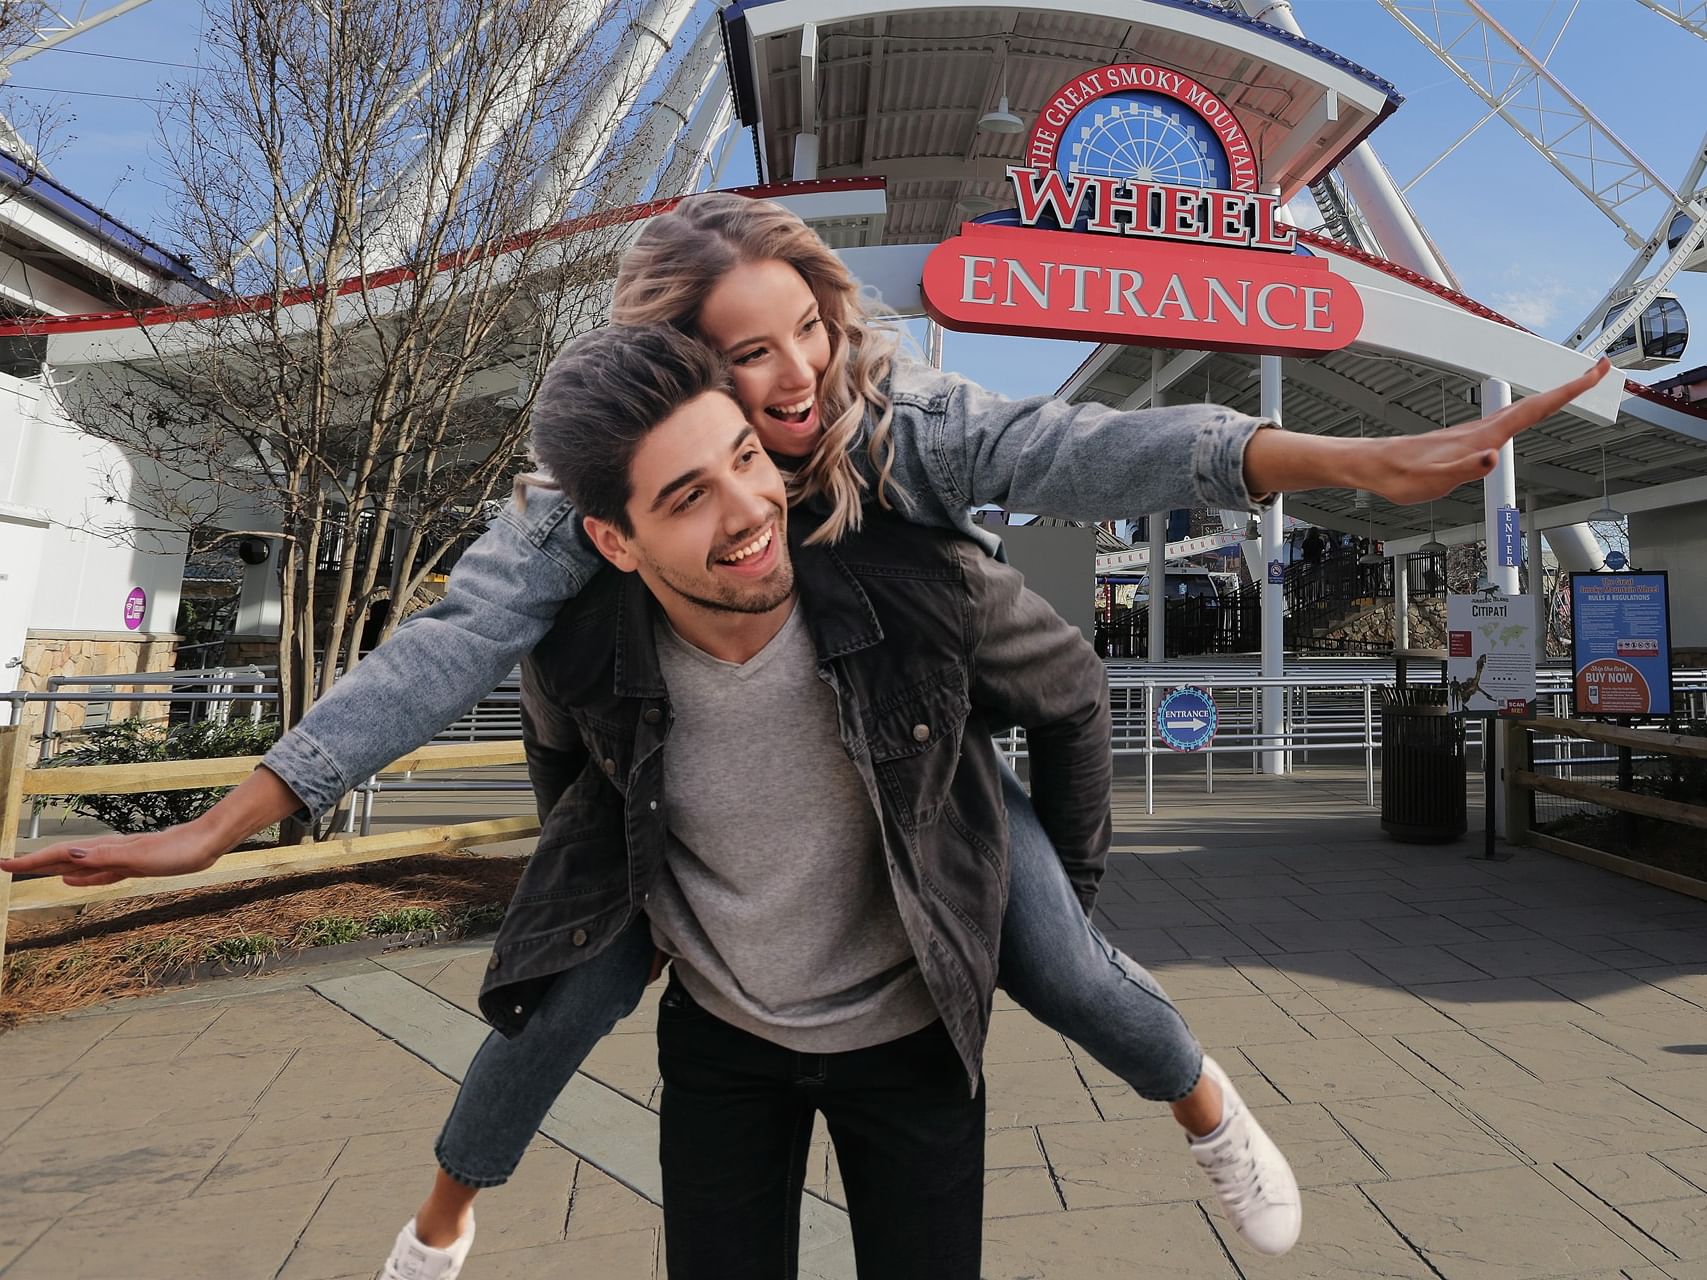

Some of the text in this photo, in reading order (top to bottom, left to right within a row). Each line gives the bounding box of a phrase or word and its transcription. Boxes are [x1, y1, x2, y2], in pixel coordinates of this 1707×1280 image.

[1031, 67, 1254, 193] THE GREAT SMOKY MOUNTAIN
[1006, 164, 1298, 252] WHEEL
[958, 254, 1336, 334] ENTRANCE
[1505, 512, 1514, 566] ENTER
[1585, 672, 1634, 683] BUY NOW
[1165, 710, 1209, 718] ENTRANCE
